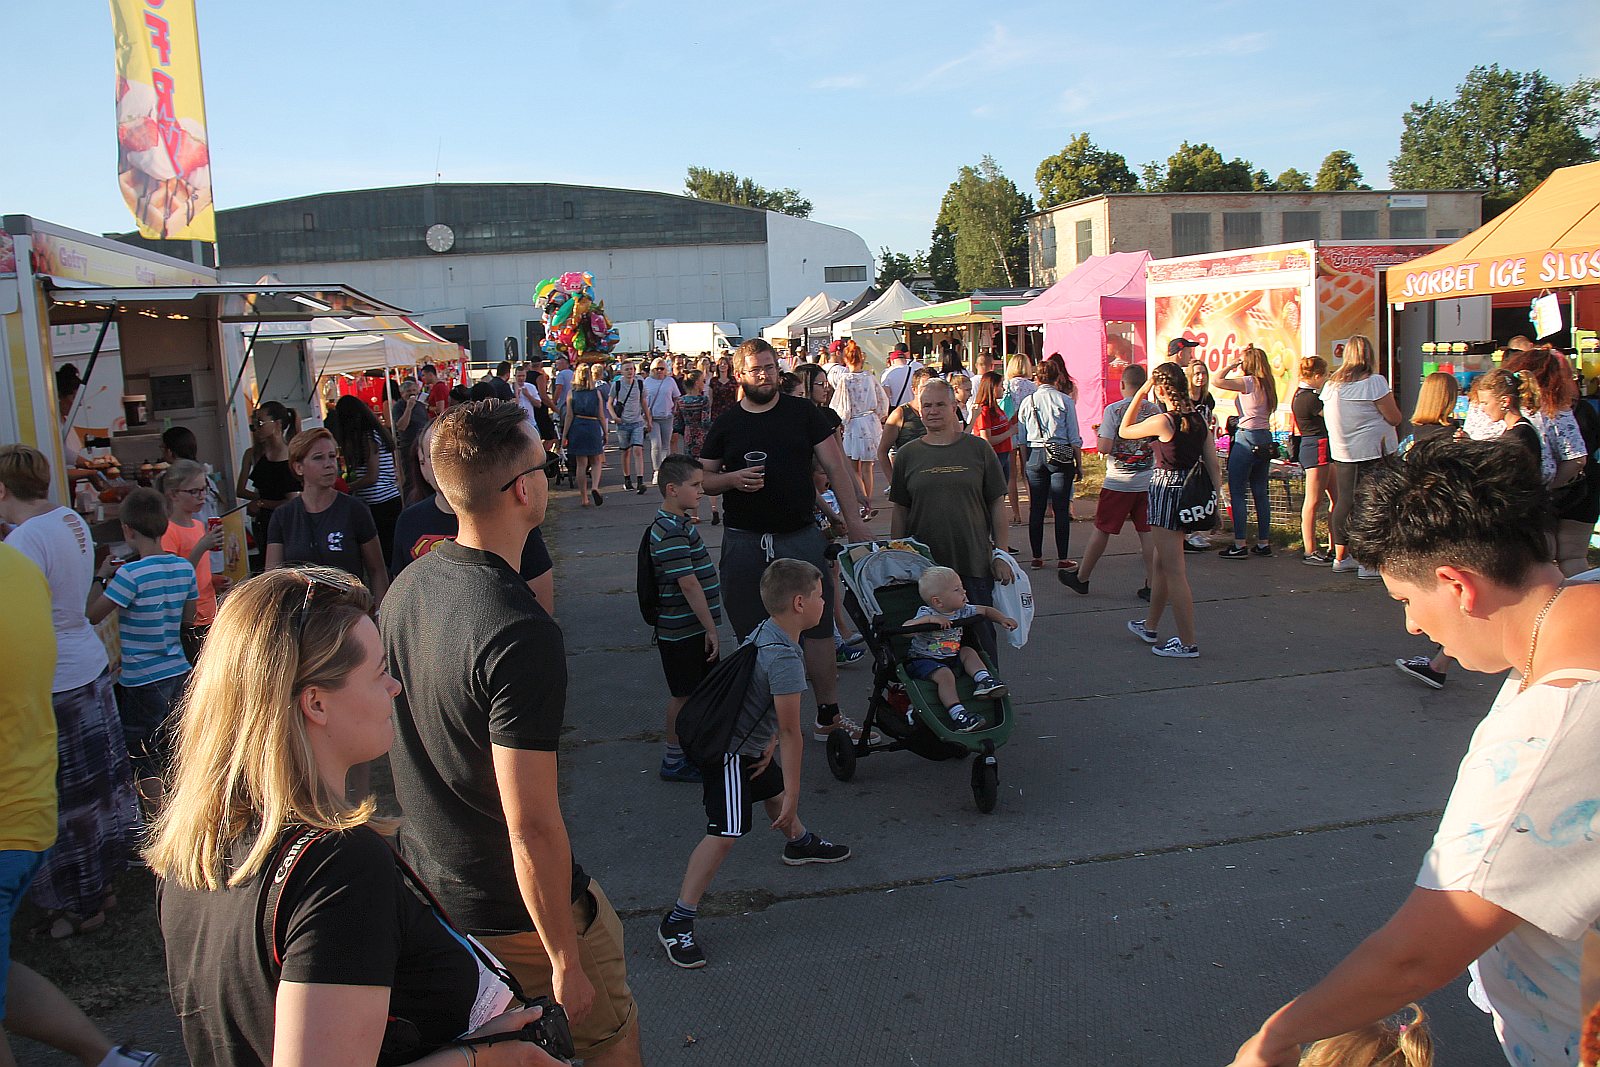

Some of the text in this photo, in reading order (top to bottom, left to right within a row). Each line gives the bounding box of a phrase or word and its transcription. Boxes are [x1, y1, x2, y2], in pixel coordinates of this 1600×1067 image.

[1402, 262, 1480, 298] SORBET
[1489, 257, 1527, 288] ICE
[274, 827, 320, 884] Canon
